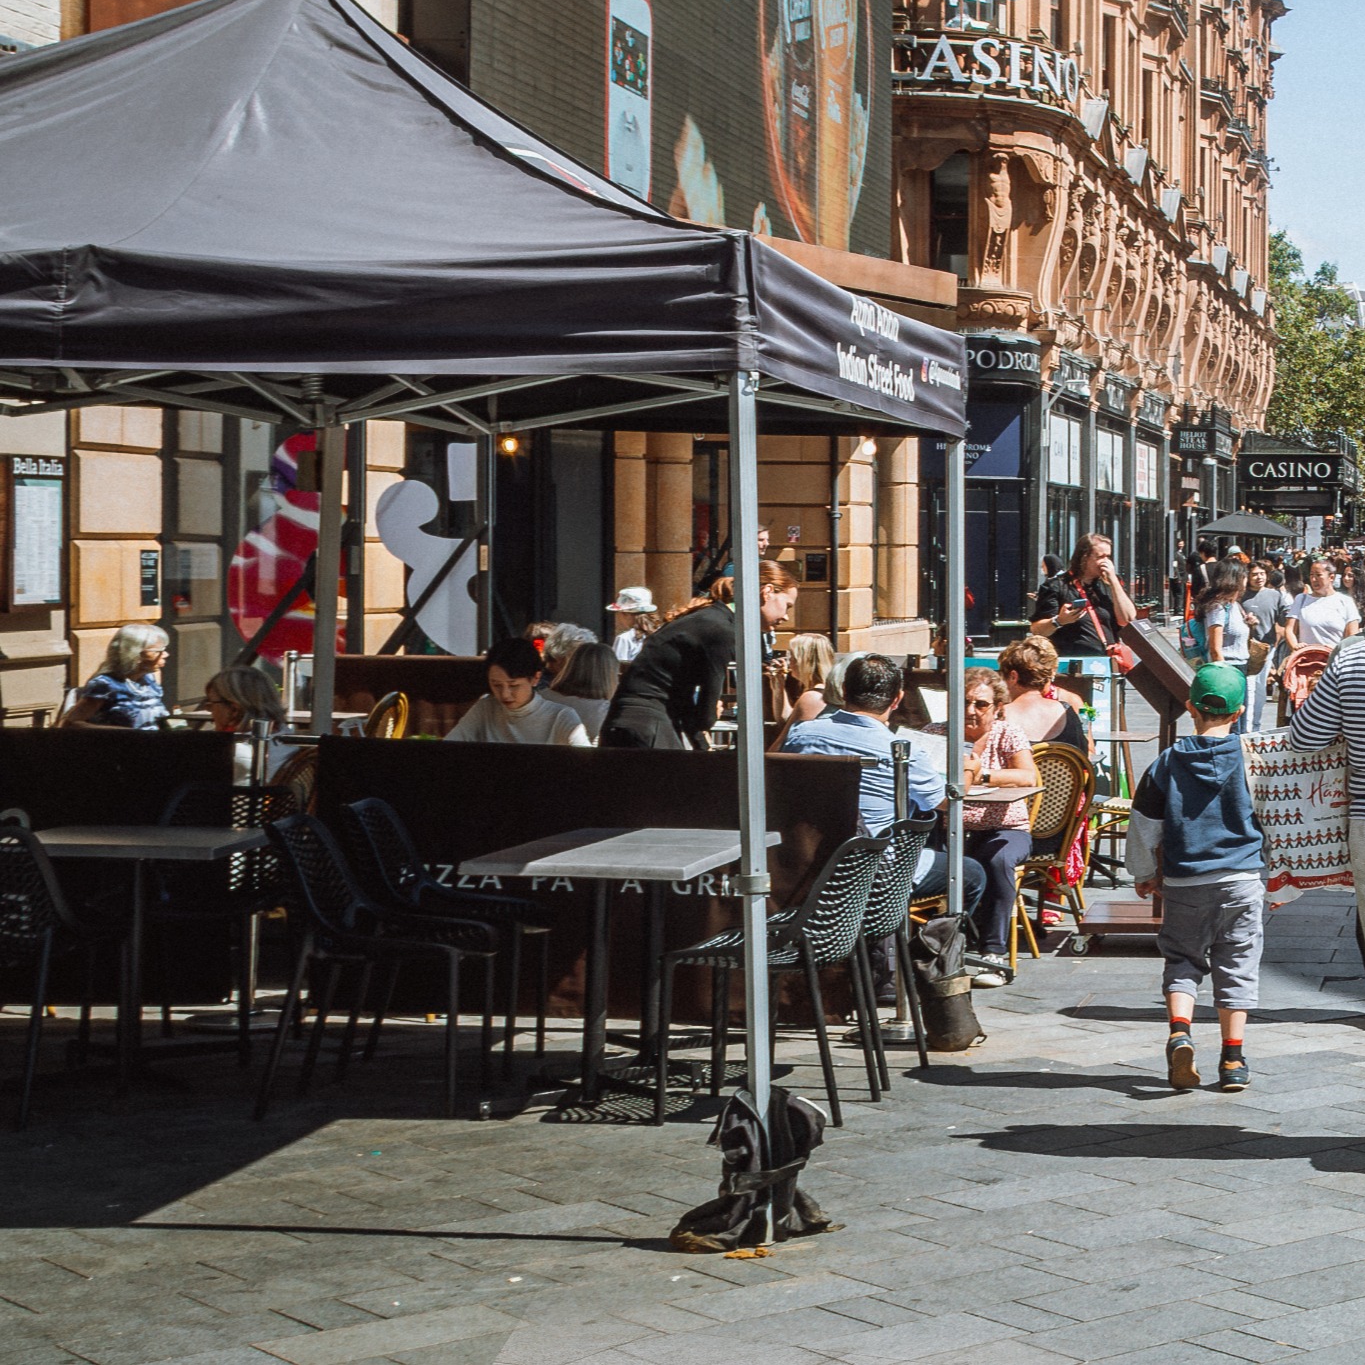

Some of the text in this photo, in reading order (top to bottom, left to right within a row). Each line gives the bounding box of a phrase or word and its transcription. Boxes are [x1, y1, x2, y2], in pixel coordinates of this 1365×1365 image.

[837, 342, 868, 386] Indian
[868, 353, 893, 395] Street
[894, 364, 915, 401] Food
[13, 458, 64, 475] Bella Italia
[1249, 462, 1331, 478] CASINO
